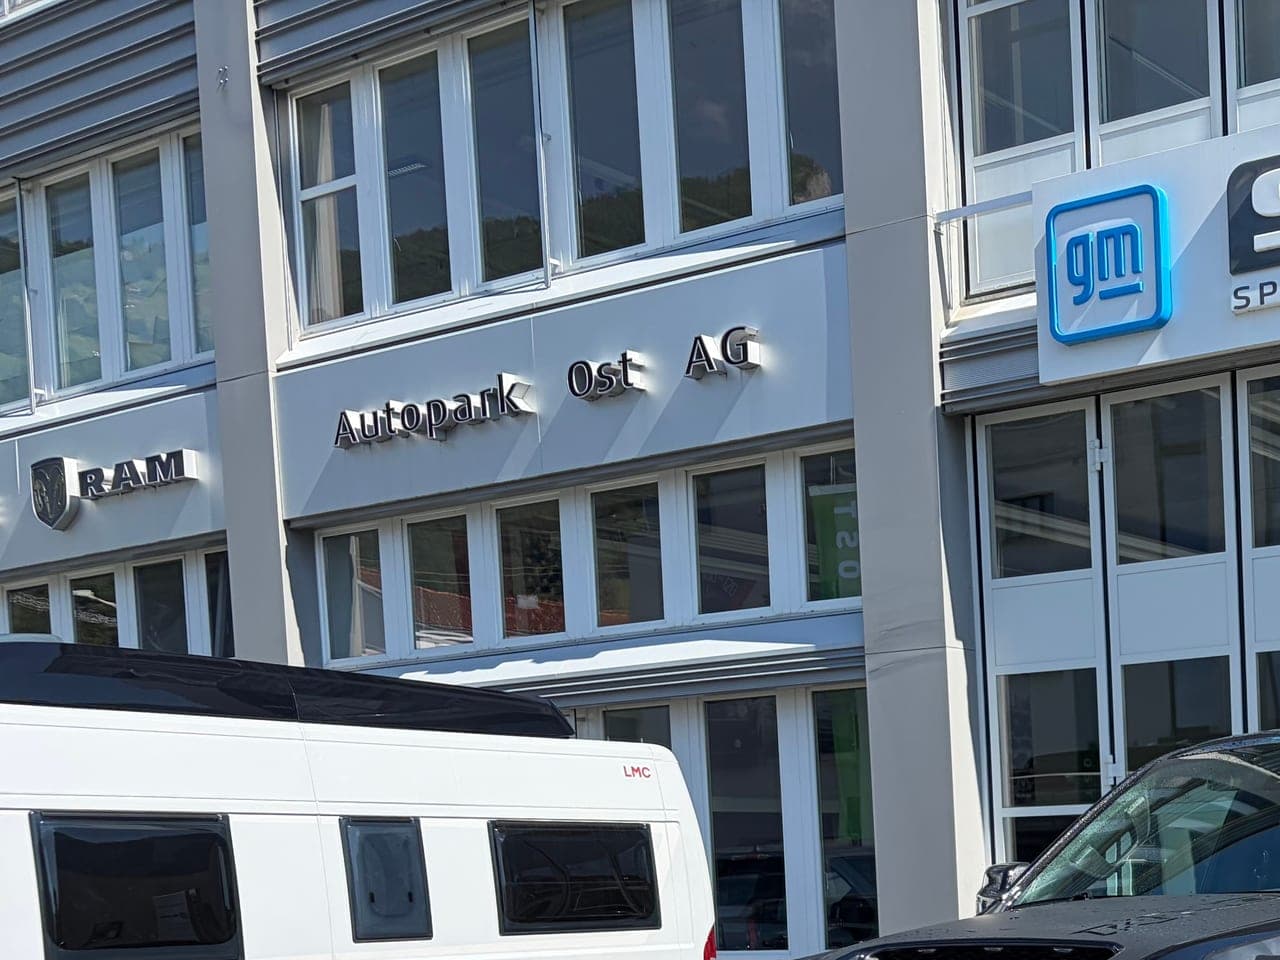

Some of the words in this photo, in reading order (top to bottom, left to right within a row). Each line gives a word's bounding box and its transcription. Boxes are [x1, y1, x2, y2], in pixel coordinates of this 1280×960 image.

[1065, 223, 1143, 306] gm
[334, 372, 529, 446] Autopark
[567, 351, 635, 399] Ost
[685, 326, 753, 376] AG
[78, 449, 186, 498] RAM
[623, 765, 651, 778] LMC
